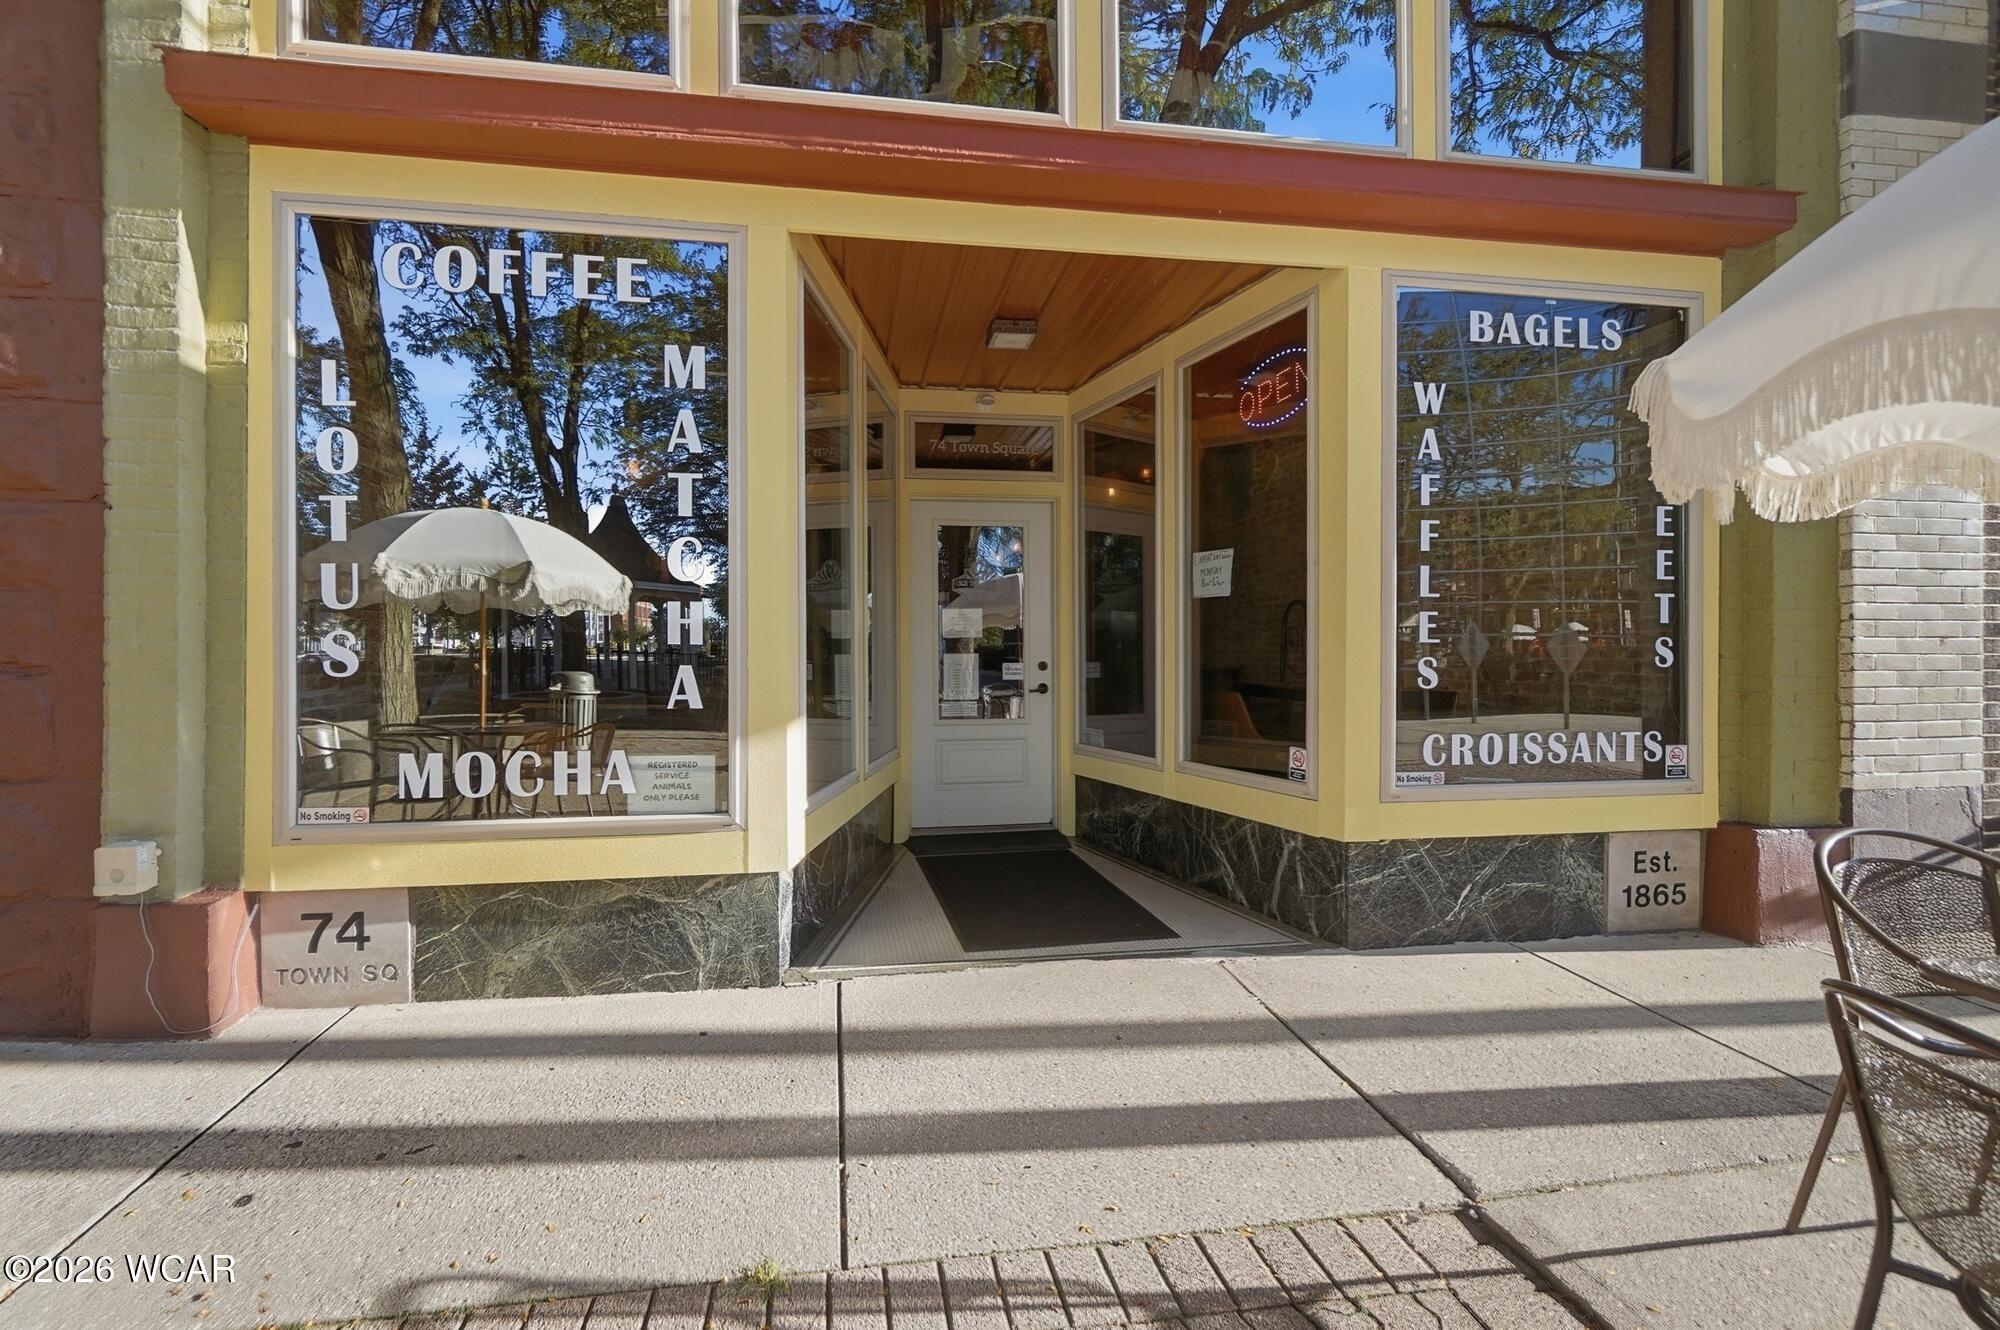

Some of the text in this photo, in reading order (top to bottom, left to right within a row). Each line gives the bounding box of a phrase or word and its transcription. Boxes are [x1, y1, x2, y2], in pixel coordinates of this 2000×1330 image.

[382, 242, 651, 303] COFFEE
[1469, 310, 1622, 351] BAGELS
[929, 439, 1039, 457] 74 Town Square
[315, 359, 360, 678] LOTUS
[664, 344, 706, 709] MATCHA
[1413, 381, 1447, 690] WAFFLES
[1654, 506, 1676, 668] EETS
[1422, 730, 1663, 767] CROISSANTS
[399, 748, 638, 799] MOCHA
[647, 761, 698, 769] REGISTERED
[655, 772, 690, 780] SERVICE
[652, 782, 692, 790] ANIMALS
[1396, 773, 1432, 784] No Smoking
[643, 793, 700, 802] ONLY PLEASE
[300, 811, 351, 823] No Smoking
[1634, 850, 1678, 874] Est.
[1622, 883, 1687, 908] 1865
[301, 911, 371, 954] 74
[275, 963, 399, 986] TOWN SQ
